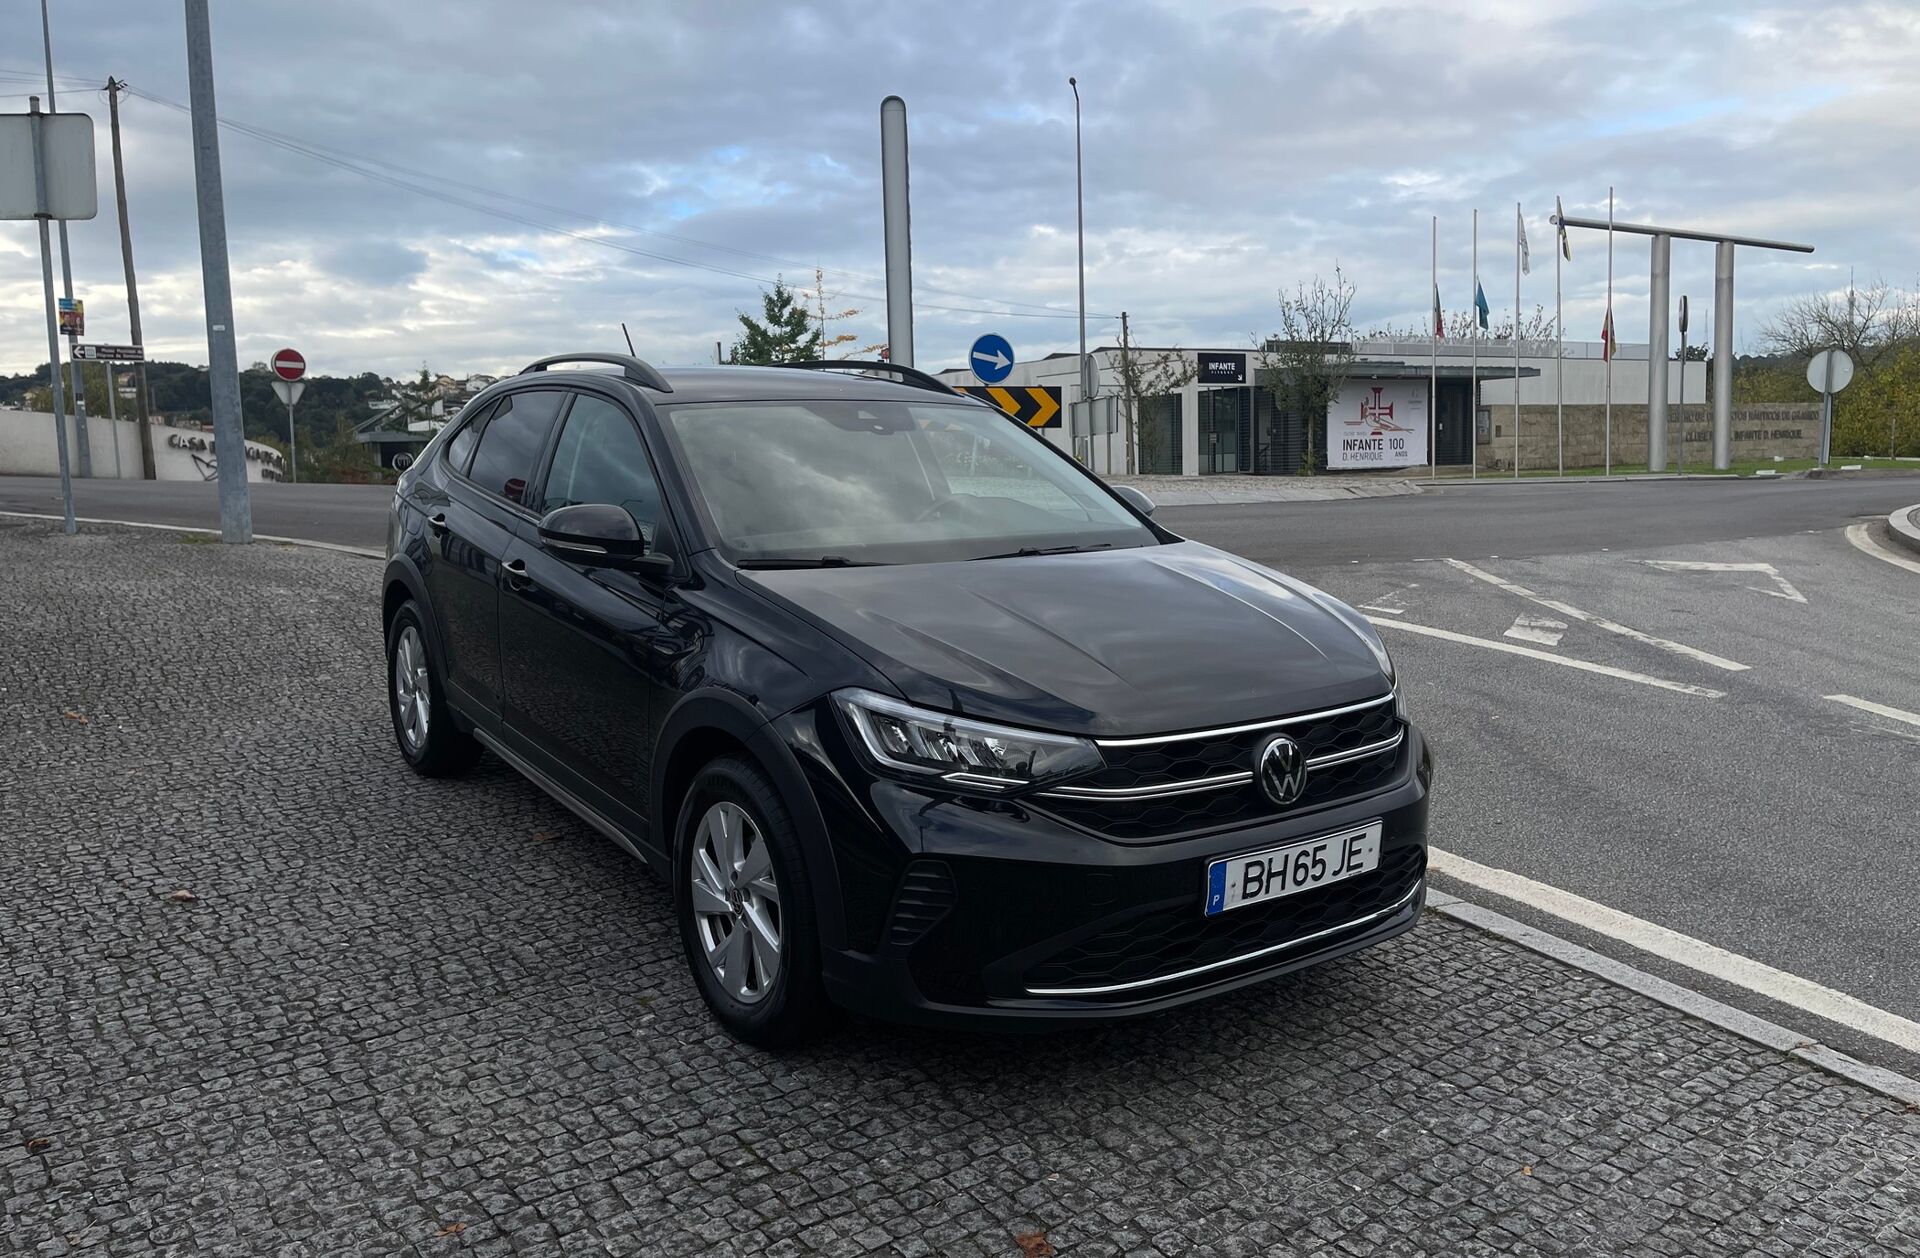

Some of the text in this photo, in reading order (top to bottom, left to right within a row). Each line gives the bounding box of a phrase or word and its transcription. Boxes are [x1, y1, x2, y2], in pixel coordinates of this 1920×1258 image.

[1208, 362, 1236, 371] INFANTE
[168, 434, 207, 451] CASA
[1343, 438, 1404, 451] INFANTE 100
[1343, 451, 1383, 462] D. HENRIQUE
[1331, 833, 1366, 876] JE
[1213, 896, 1219, 905] P
